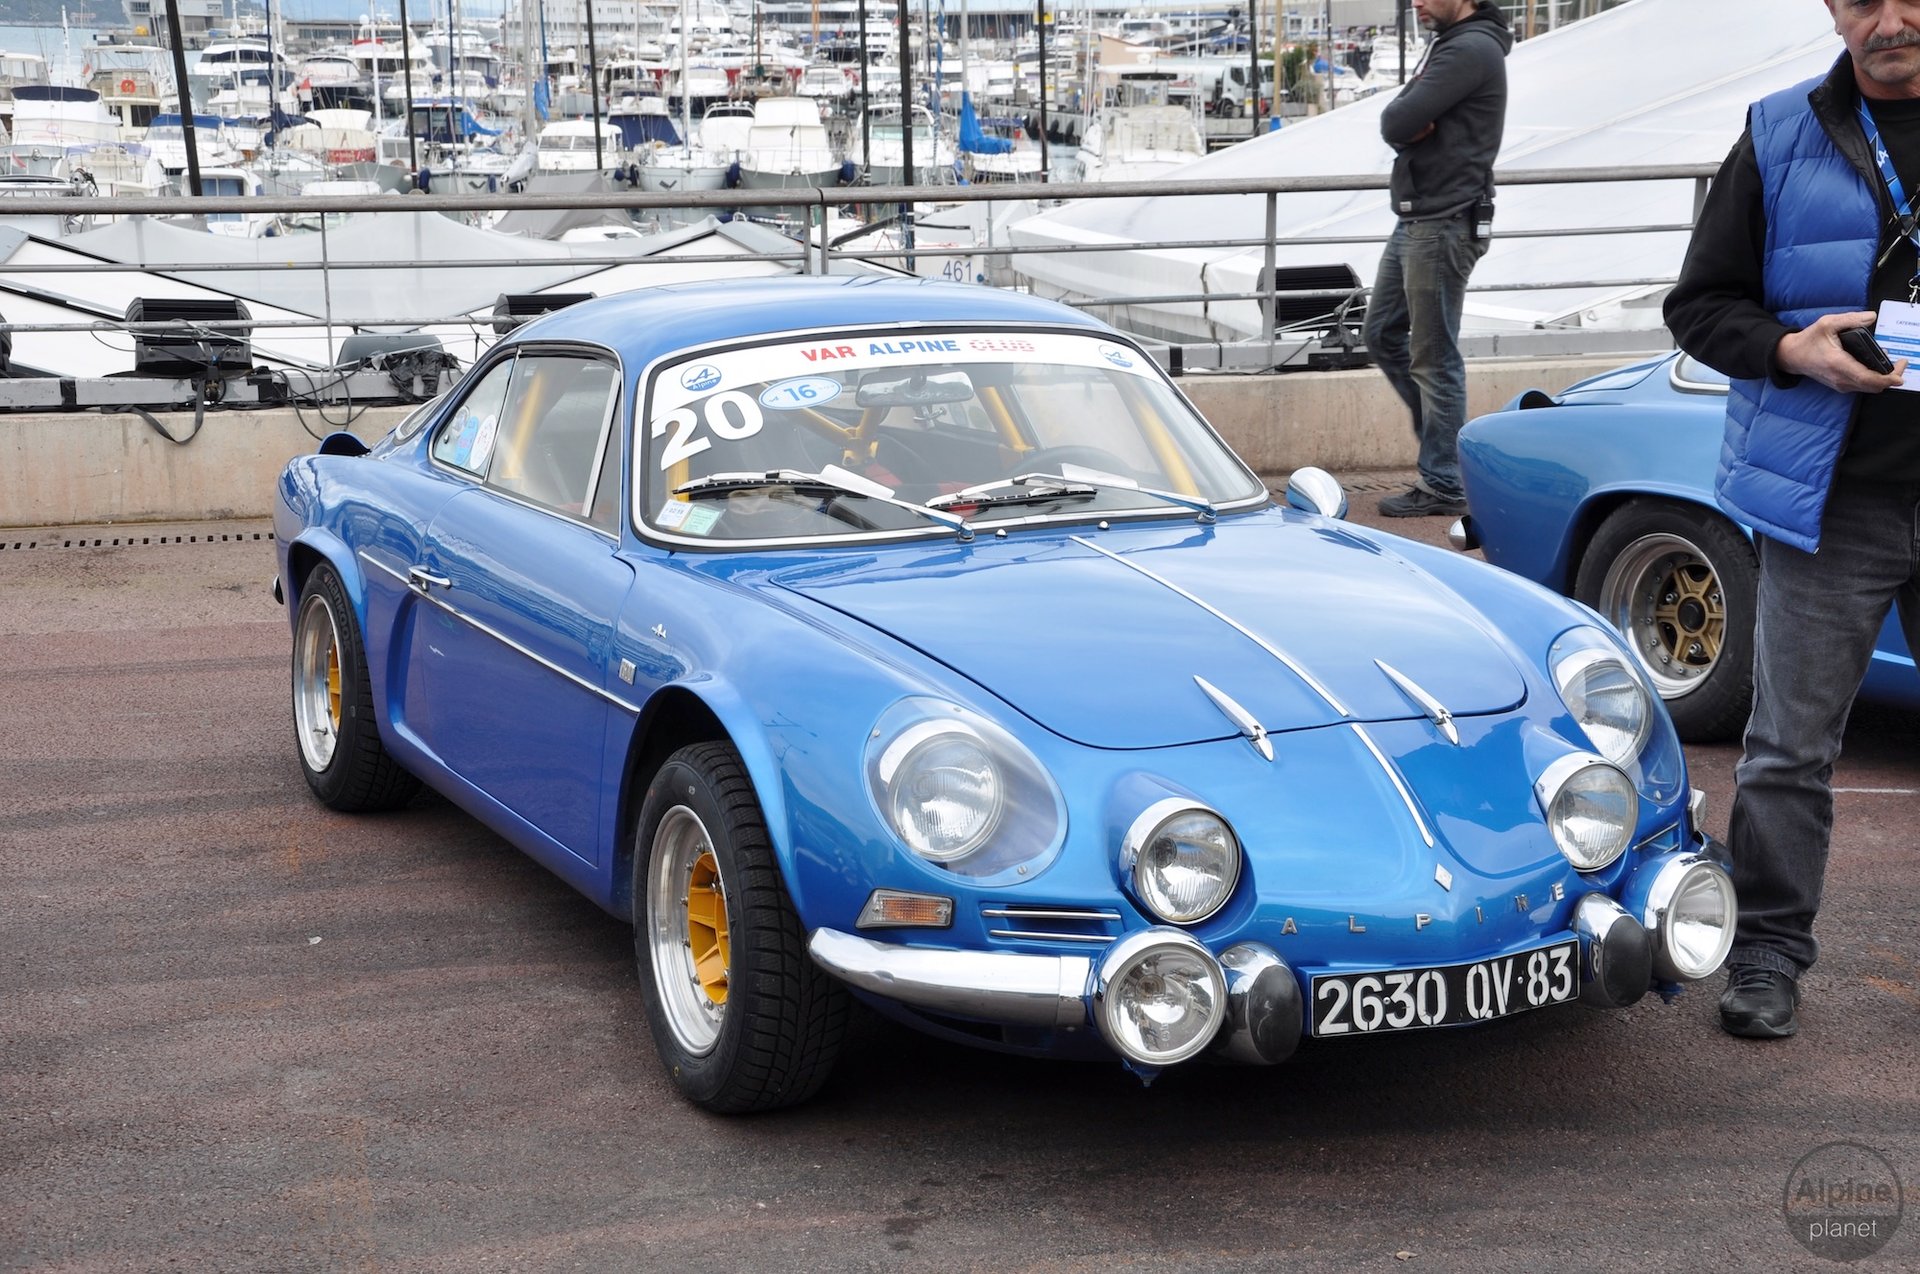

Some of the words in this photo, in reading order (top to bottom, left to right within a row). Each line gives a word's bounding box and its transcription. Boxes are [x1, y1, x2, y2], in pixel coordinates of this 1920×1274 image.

[942, 260, 972, 283] 461
[801, 345, 857, 363] VAR
[869, 339, 961, 356] ALPINE
[969, 338, 1037, 352] CLUB
[783, 383, 818, 402] 16
[651, 390, 764, 472] 20
[1280, 881, 1566, 936] ALPINE
[1317, 970, 1448, 1035] 2630
[1465, 957, 1514, 1020] QV
[1526, 946, 1572, 1007] 83
